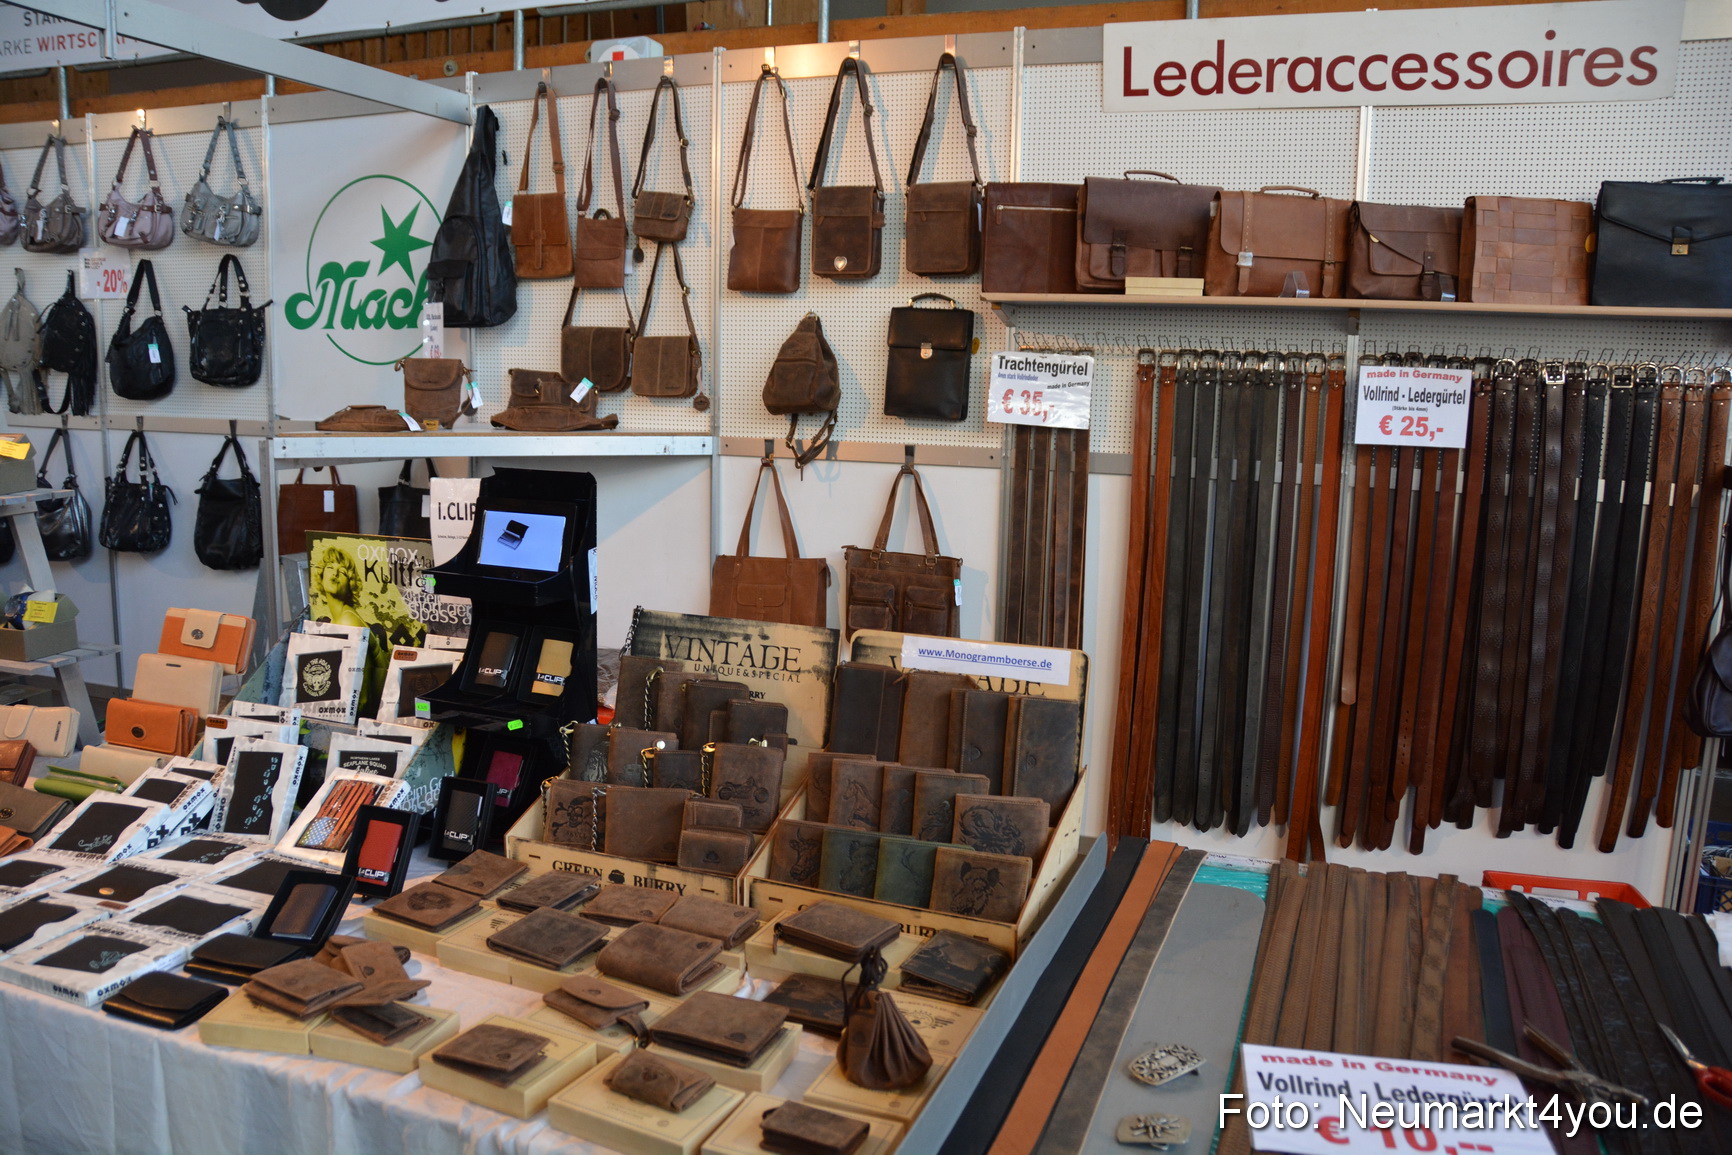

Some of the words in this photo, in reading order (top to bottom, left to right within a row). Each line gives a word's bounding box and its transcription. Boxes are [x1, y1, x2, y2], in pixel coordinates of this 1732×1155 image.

[1122, 28, 1658, 97] Lederaccessoires
[103, 269, 128, 293] 20%
[998, 355, 1088, 377] Trachtengürtel
[1367, 370, 1396, 379] made
[1400, 370, 1409, 378] in
[1412, 370, 1463, 383] Germany
[1067, 381, 1090, 389] Germany
[1363, 385, 1400, 402] Vollrind
[1408, 387, 1466, 407] Ledergürtel
[1002, 388, 1015, 414] €
[1379, 415, 1393, 436] €
[1400, 415, 1444, 442] 25,-
[357, 544, 418, 564] OXMOX
[664, 634, 802, 673] VINTAGE
[918, 646, 1053, 671] www.Monogrammboerse.de
[1261, 1054, 1333, 1068] made
[1342, 1058, 1366, 1070] in
[1374, 1061, 1498, 1087] Germany
[1256, 1071, 1353, 1099] Vollrind
[1316, 1116, 1350, 1145] €
